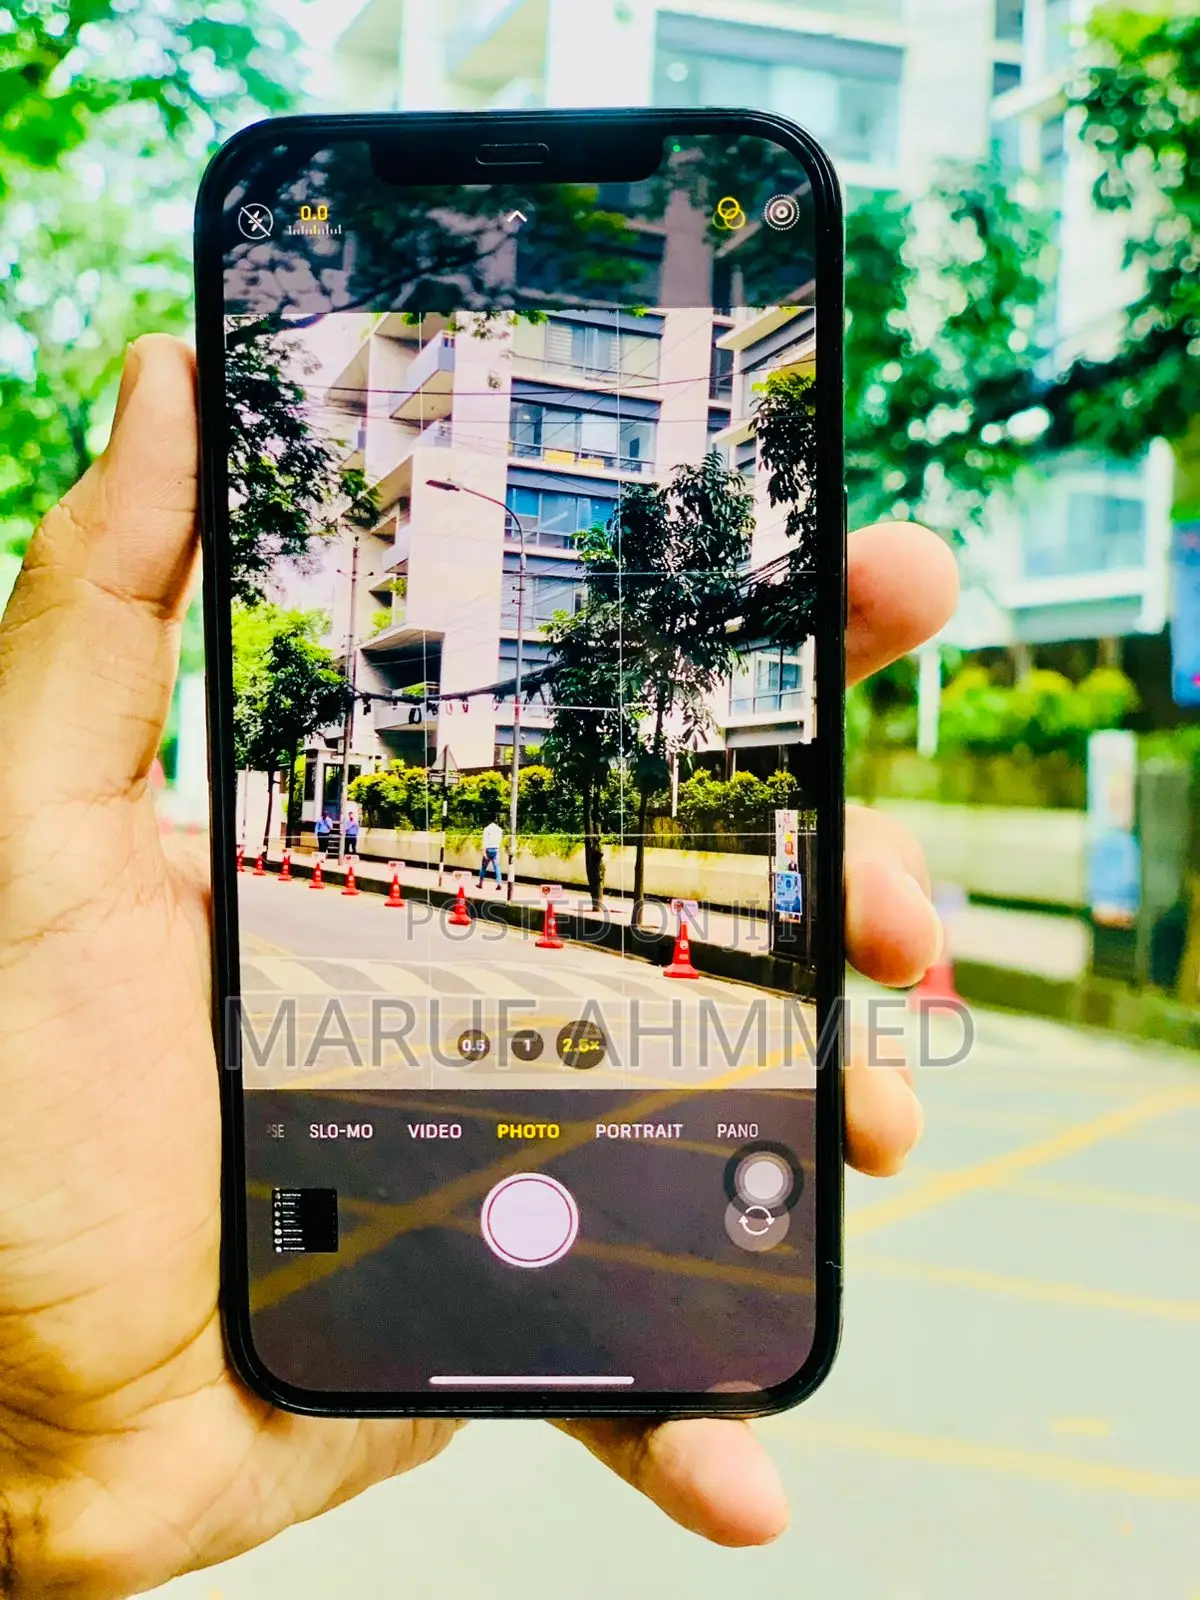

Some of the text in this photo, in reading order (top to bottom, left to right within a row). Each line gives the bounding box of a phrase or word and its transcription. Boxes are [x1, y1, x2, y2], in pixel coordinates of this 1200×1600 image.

[301, 205, 328, 221] 0.0
[462, 1039, 486, 1052] 0.5
[523, 1039, 531, 1051] 1
[309, 1123, 374, 1139] SLO-MO
[407, 1123, 463, 1139] VIDEO
[497, 1123, 560, 1139] PHOTO
[595, 1123, 683, 1139] PORTRAIT
[716, 1123, 759, 1138] PANO
